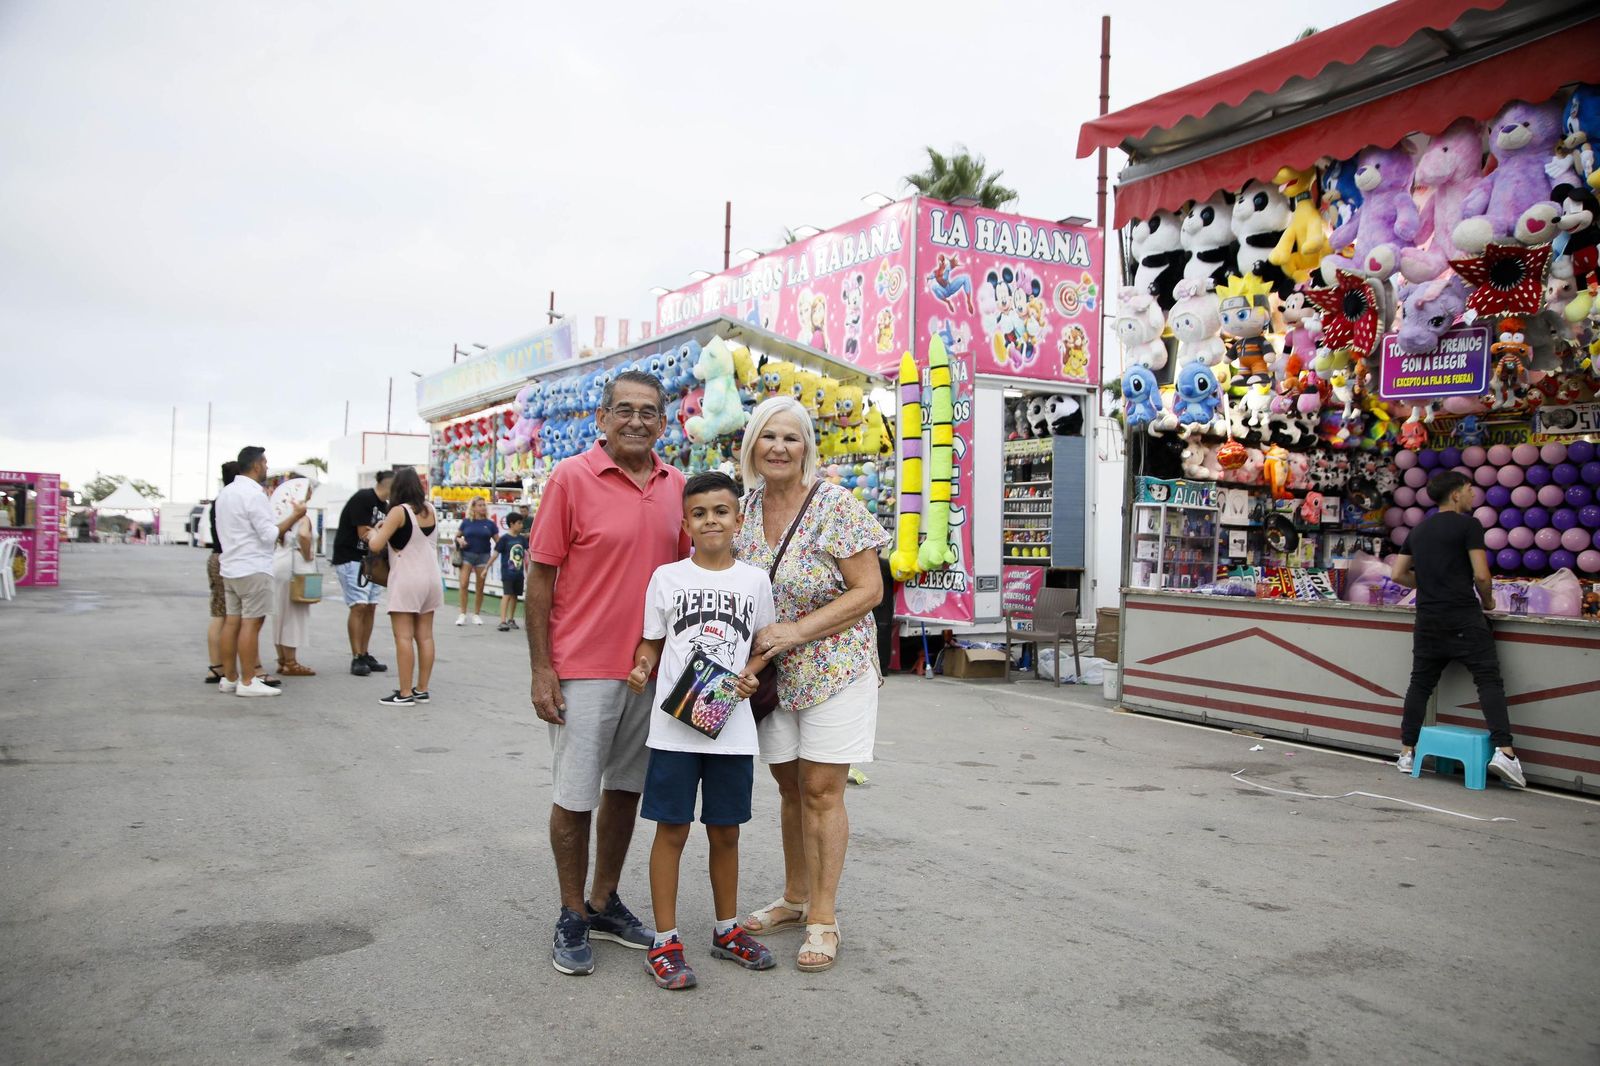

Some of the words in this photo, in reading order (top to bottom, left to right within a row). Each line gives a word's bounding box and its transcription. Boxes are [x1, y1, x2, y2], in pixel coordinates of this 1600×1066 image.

[931, 210, 969, 248] LA
[975, 217, 1090, 267] HABANA
[660, 292, 700, 328] SALON
[703, 286, 721, 314] DE
[723, 265, 784, 307] JUEGOS
[786, 252, 810, 286] LA
[814, 219, 903, 278] HABANA
[1441, 336, 1482, 354] PREMIOS
[922, 361, 968, 387] HNA
[1402, 357, 1422, 373] SON
[1424, 358, 1430, 371] A
[1432, 354, 1467, 371] ELEGIR
[1422, 376, 1429, 386] LA
[1430, 376, 1443, 386] FILA
[1444, 375, 1451, 385] DE
[1452, 372, 1474, 384] FUERA)
[673, 588, 755, 628] REBELS
[704, 625, 724, 639] BULL
